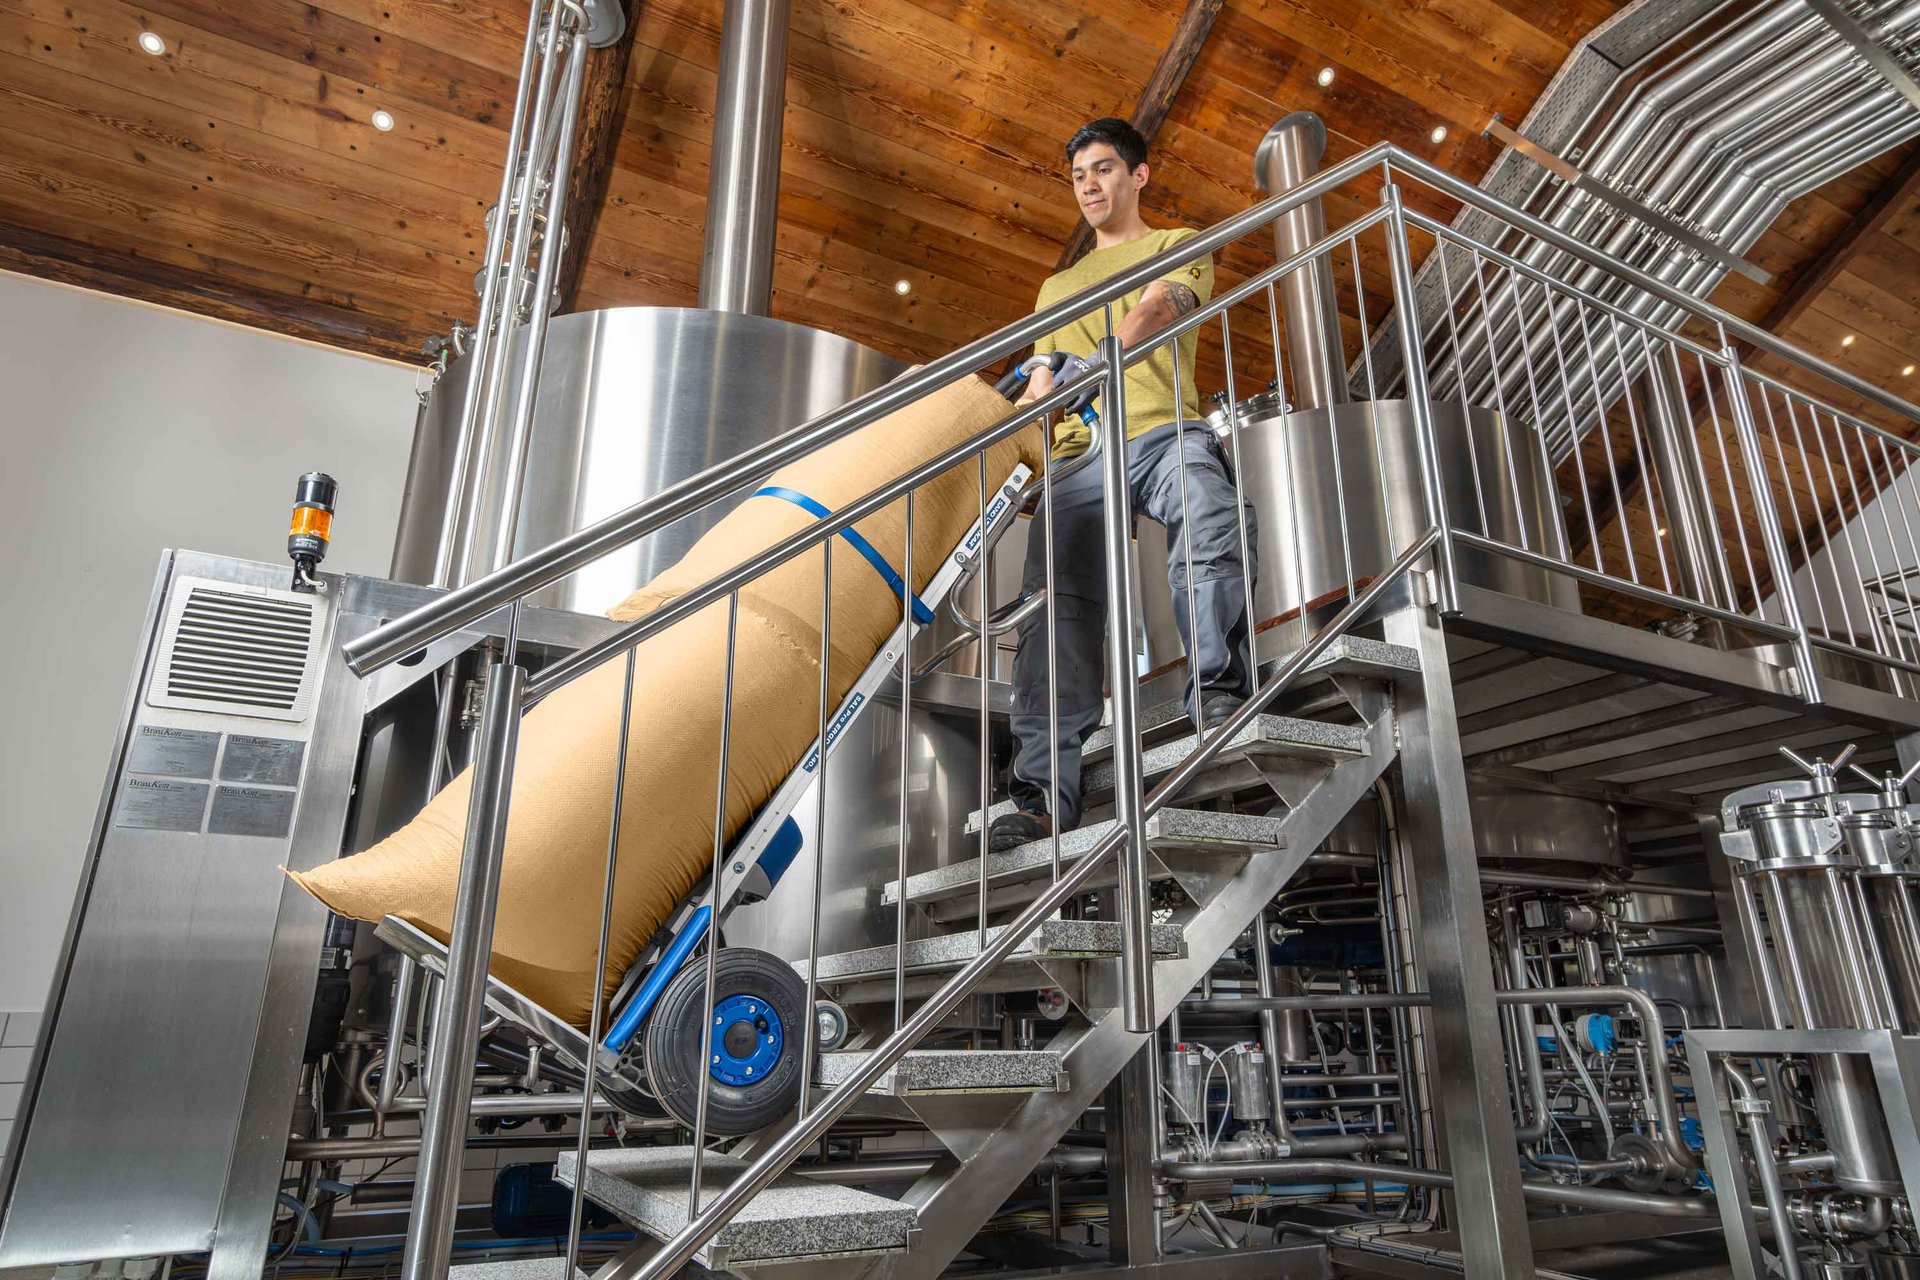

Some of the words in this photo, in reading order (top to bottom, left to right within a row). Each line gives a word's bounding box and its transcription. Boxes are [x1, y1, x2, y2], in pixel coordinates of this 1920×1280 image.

[990, 500, 1004, 517] SANO
[969, 517, 992, 546] LKAR
[849, 695, 862, 709] SAL
[840, 710, 851, 723] Pro
[808, 753, 819, 767] 140
